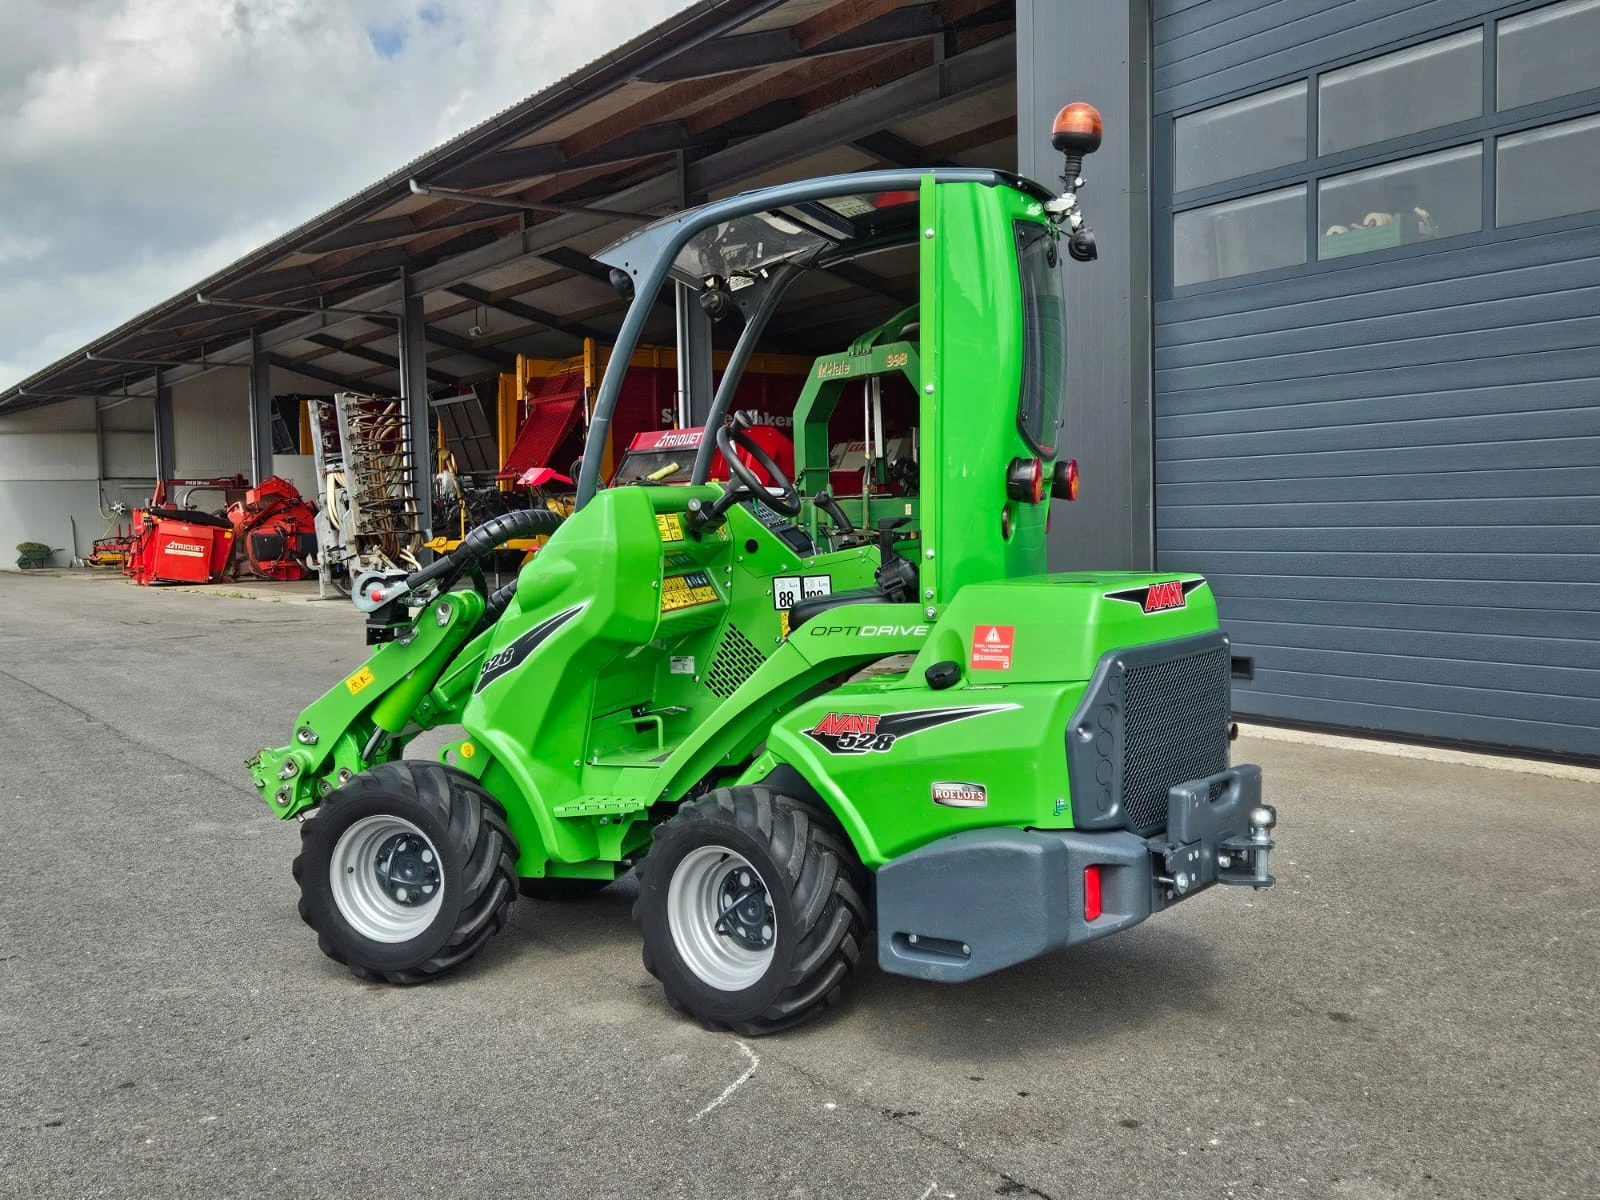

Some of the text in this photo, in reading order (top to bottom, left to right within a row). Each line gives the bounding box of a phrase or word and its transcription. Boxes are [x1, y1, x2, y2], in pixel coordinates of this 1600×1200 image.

[779, 591, 794, 607] 88
[1145, 581, 1185, 611] AVANT
[810, 625, 929, 636] OPTIDRIVE
[811, 712, 881, 736] AVANT
[837, 732, 896, 753] 528
[935, 789, 984, 801] ROELOFS
